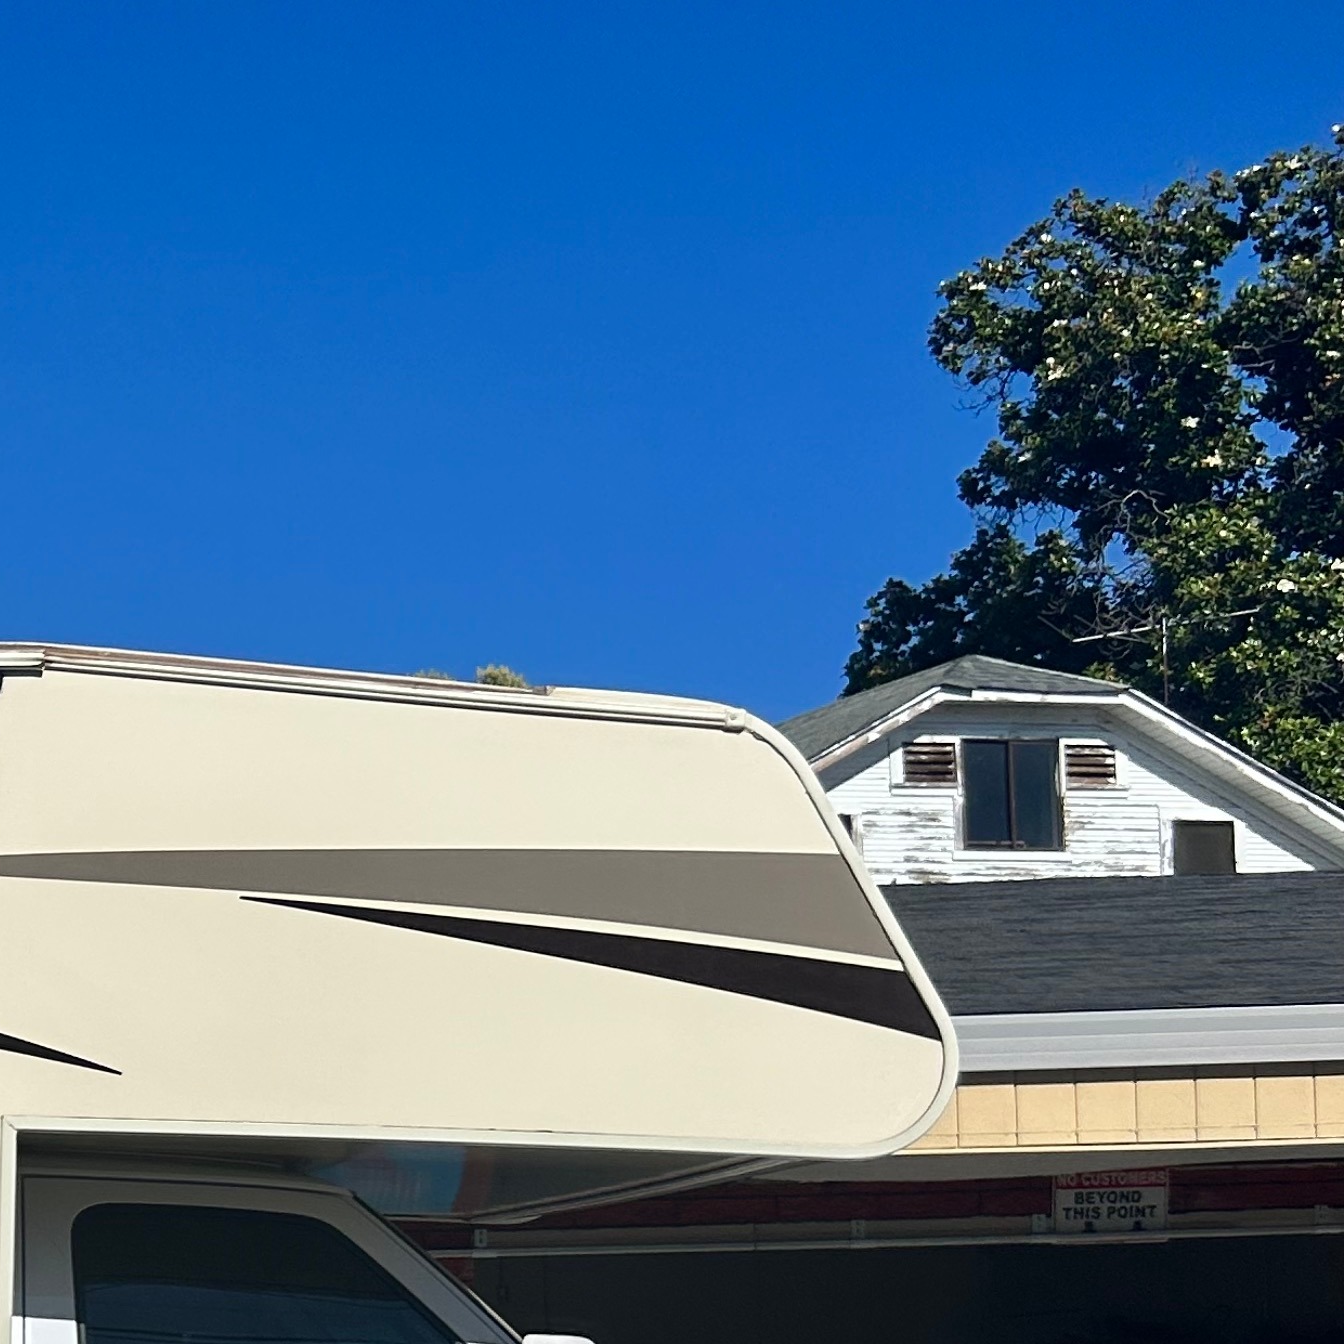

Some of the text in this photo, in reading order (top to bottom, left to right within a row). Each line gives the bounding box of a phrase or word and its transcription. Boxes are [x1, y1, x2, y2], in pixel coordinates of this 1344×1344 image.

[1056, 1171, 1167, 1187] NO CUSTOMERS
[1074, 1190, 1142, 1205] BEYOND
[1063, 1205, 1157, 1220] THIS POINT
